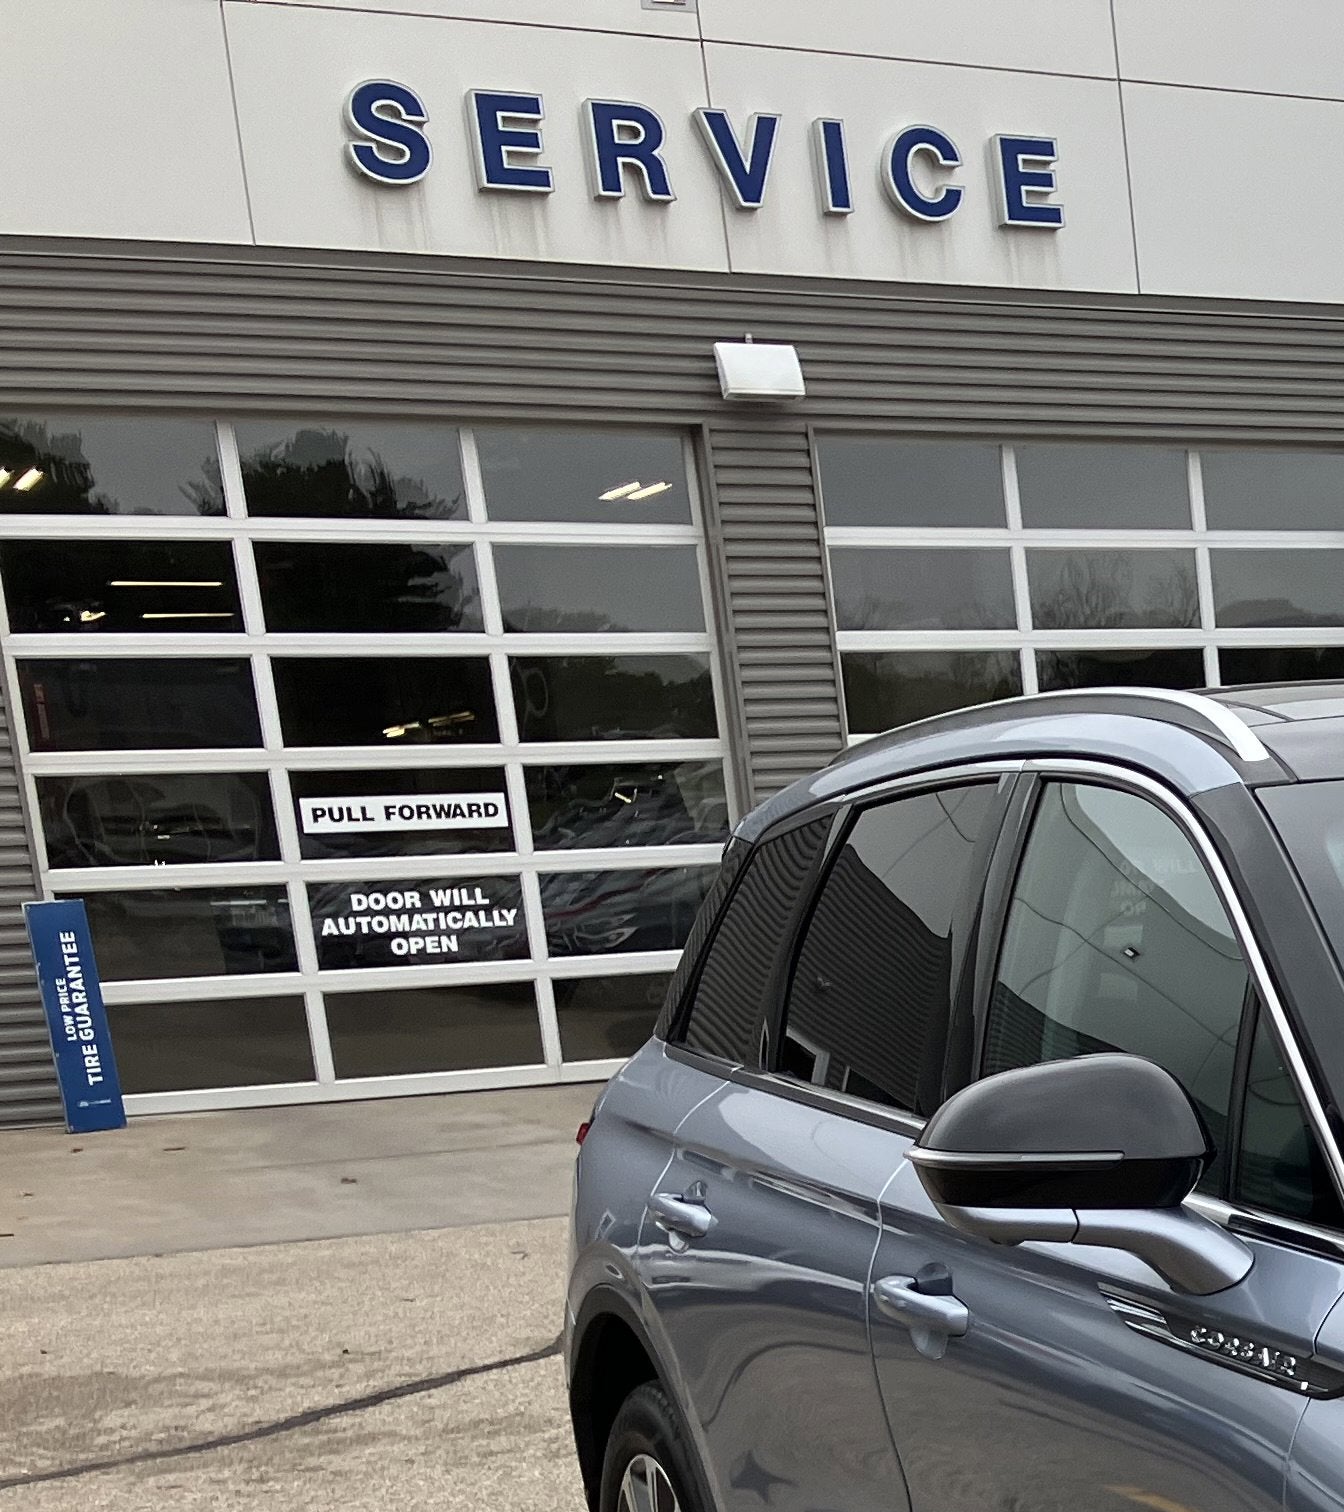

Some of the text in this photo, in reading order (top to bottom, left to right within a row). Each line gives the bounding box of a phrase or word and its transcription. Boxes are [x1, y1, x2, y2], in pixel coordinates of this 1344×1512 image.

[343, 78, 1065, 230] SERVICE
[311, 802, 499, 824] PULL FORWARD
[350, 887, 490, 912] DOOR WILL
[321, 908, 517, 937] AUTOMATICALLY
[390, 934, 459, 956] OPEN
[55, 977, 77, 1042] LOW PRICE
[59, 930, 104, 1087] TIRE GUARANTEE
